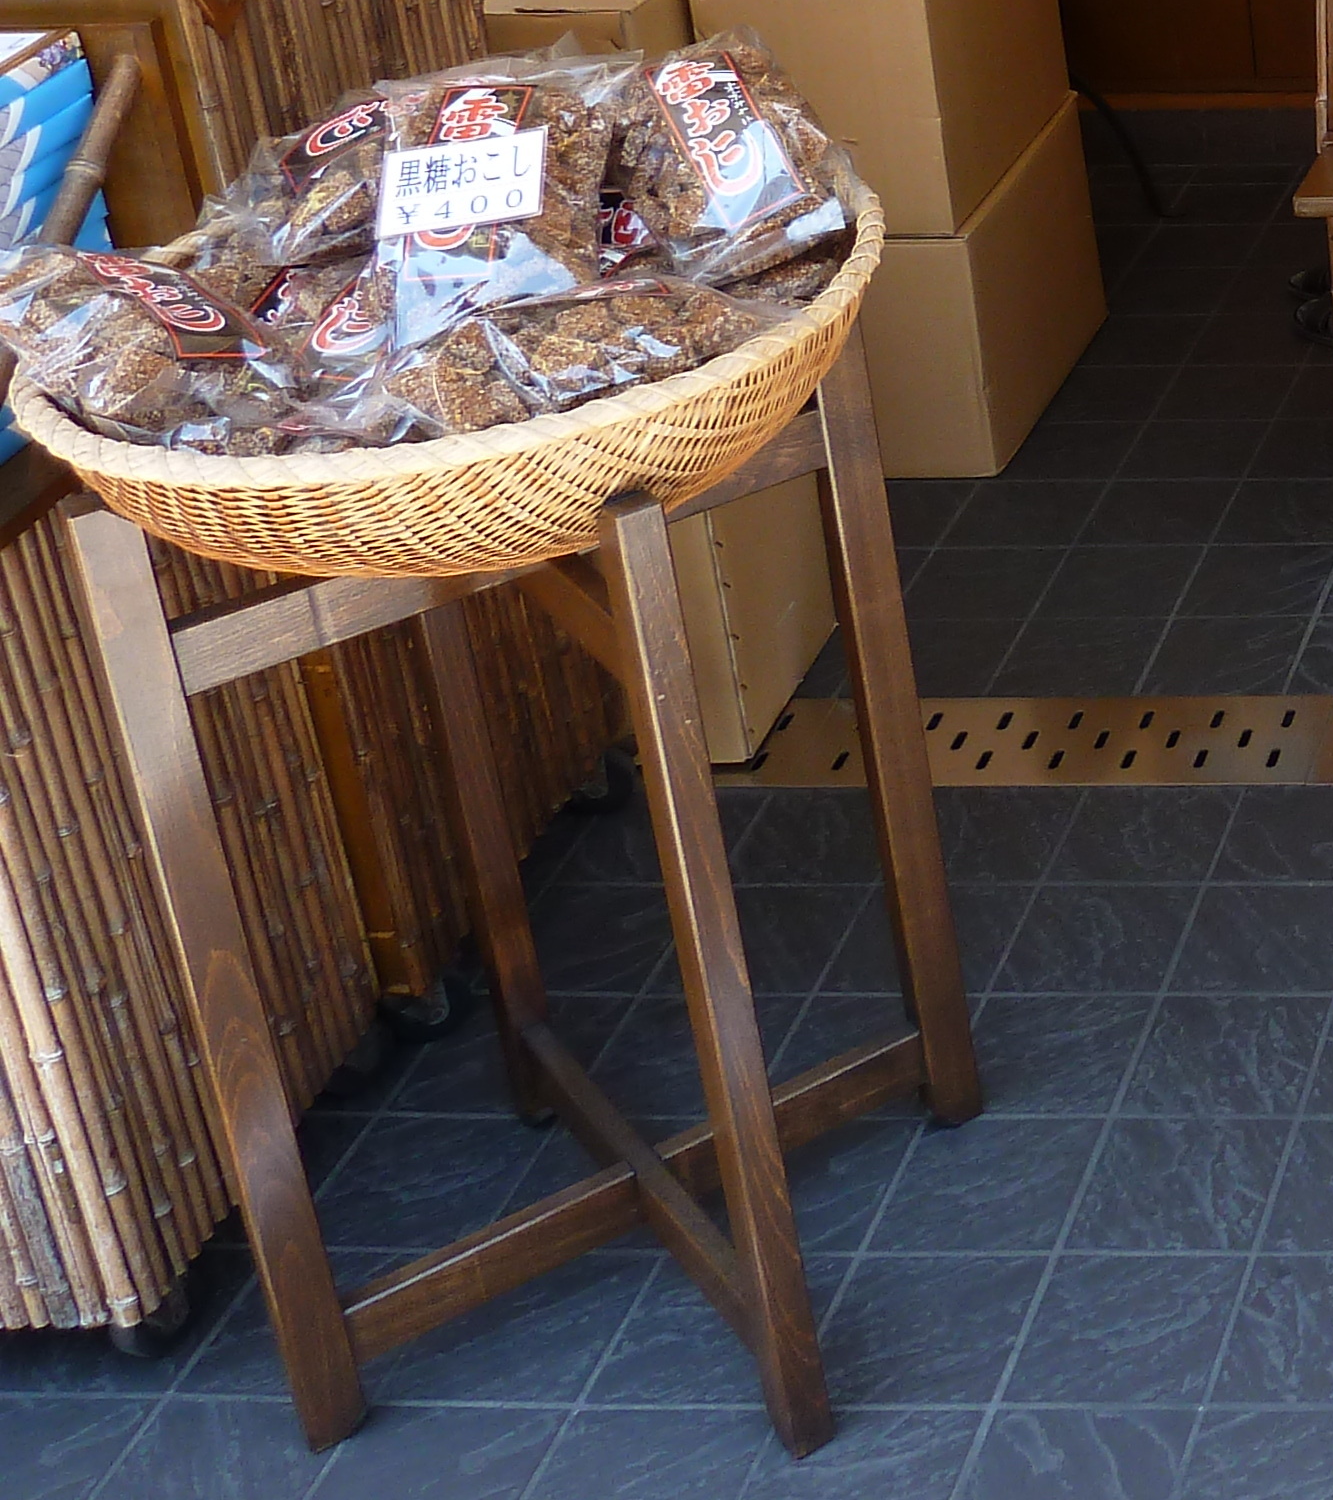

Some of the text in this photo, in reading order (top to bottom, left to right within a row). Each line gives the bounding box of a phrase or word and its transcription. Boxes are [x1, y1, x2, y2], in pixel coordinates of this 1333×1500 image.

[395, 145, 532, 198] 黒糖おこし
[396, 188, 524, 226] ¥400
